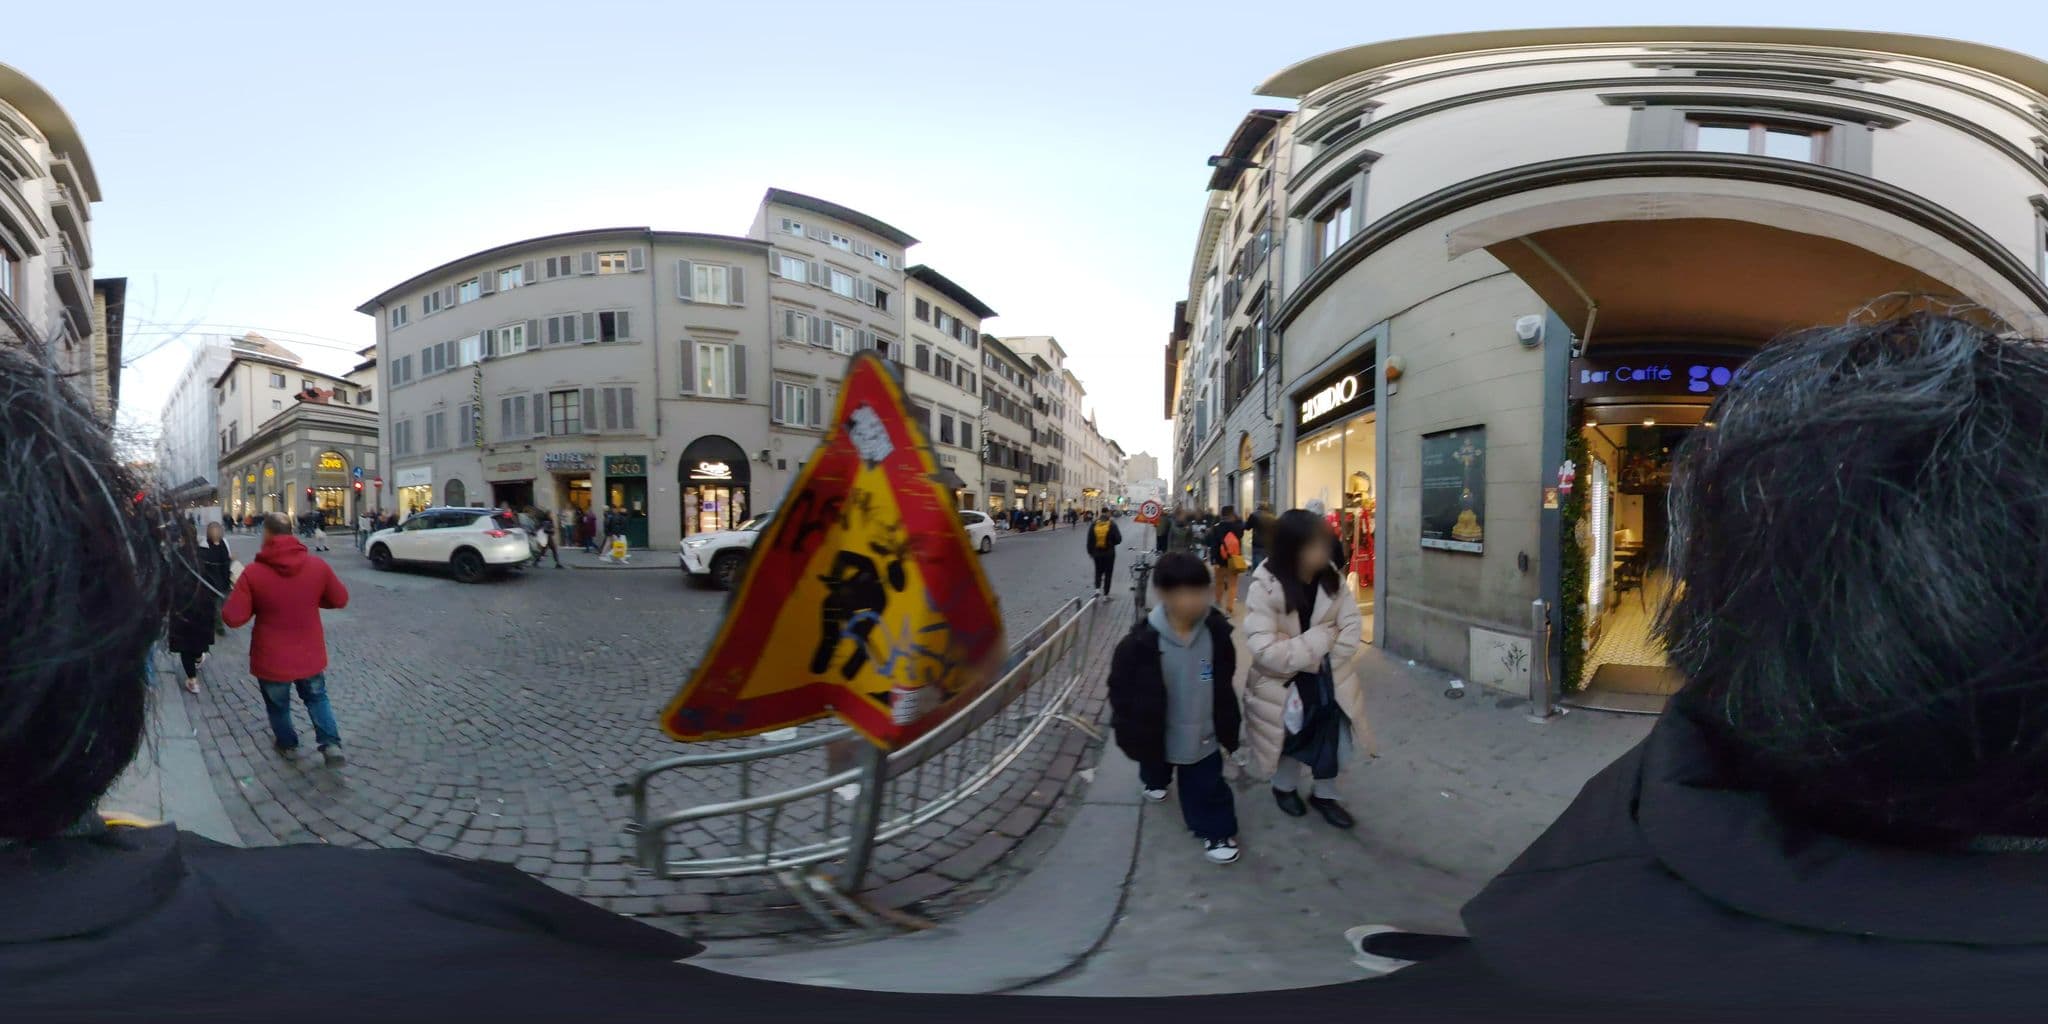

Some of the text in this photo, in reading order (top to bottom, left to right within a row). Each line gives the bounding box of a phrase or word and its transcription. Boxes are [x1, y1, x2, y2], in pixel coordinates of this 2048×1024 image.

[1580, 368, 1609, 384] Bar
[1615, 364, 1673, 382] Caffé
[544, 452, 585, 463] HOTEL
